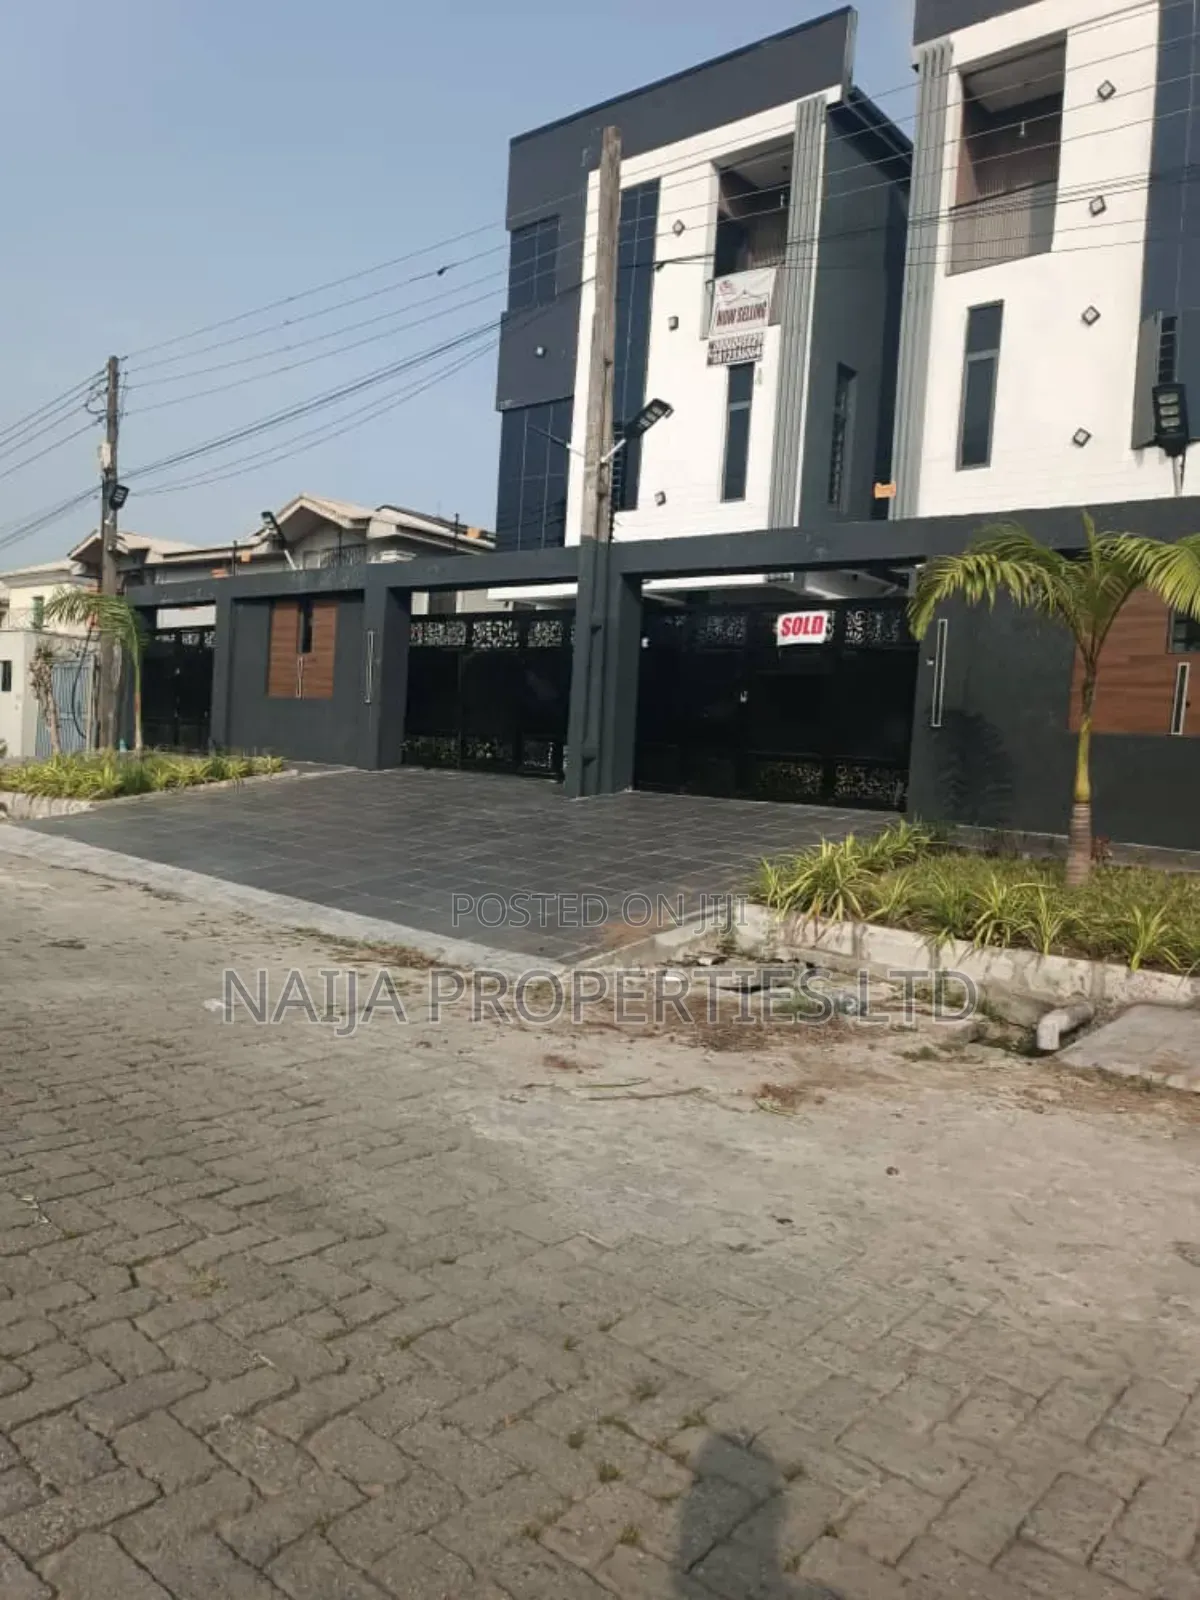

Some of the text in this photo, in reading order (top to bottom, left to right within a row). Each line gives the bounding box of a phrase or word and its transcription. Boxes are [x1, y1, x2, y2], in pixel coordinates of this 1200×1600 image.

[716, 301, 767, 326] NOW SELLING
[781, 615, 824, 637] SOLD
